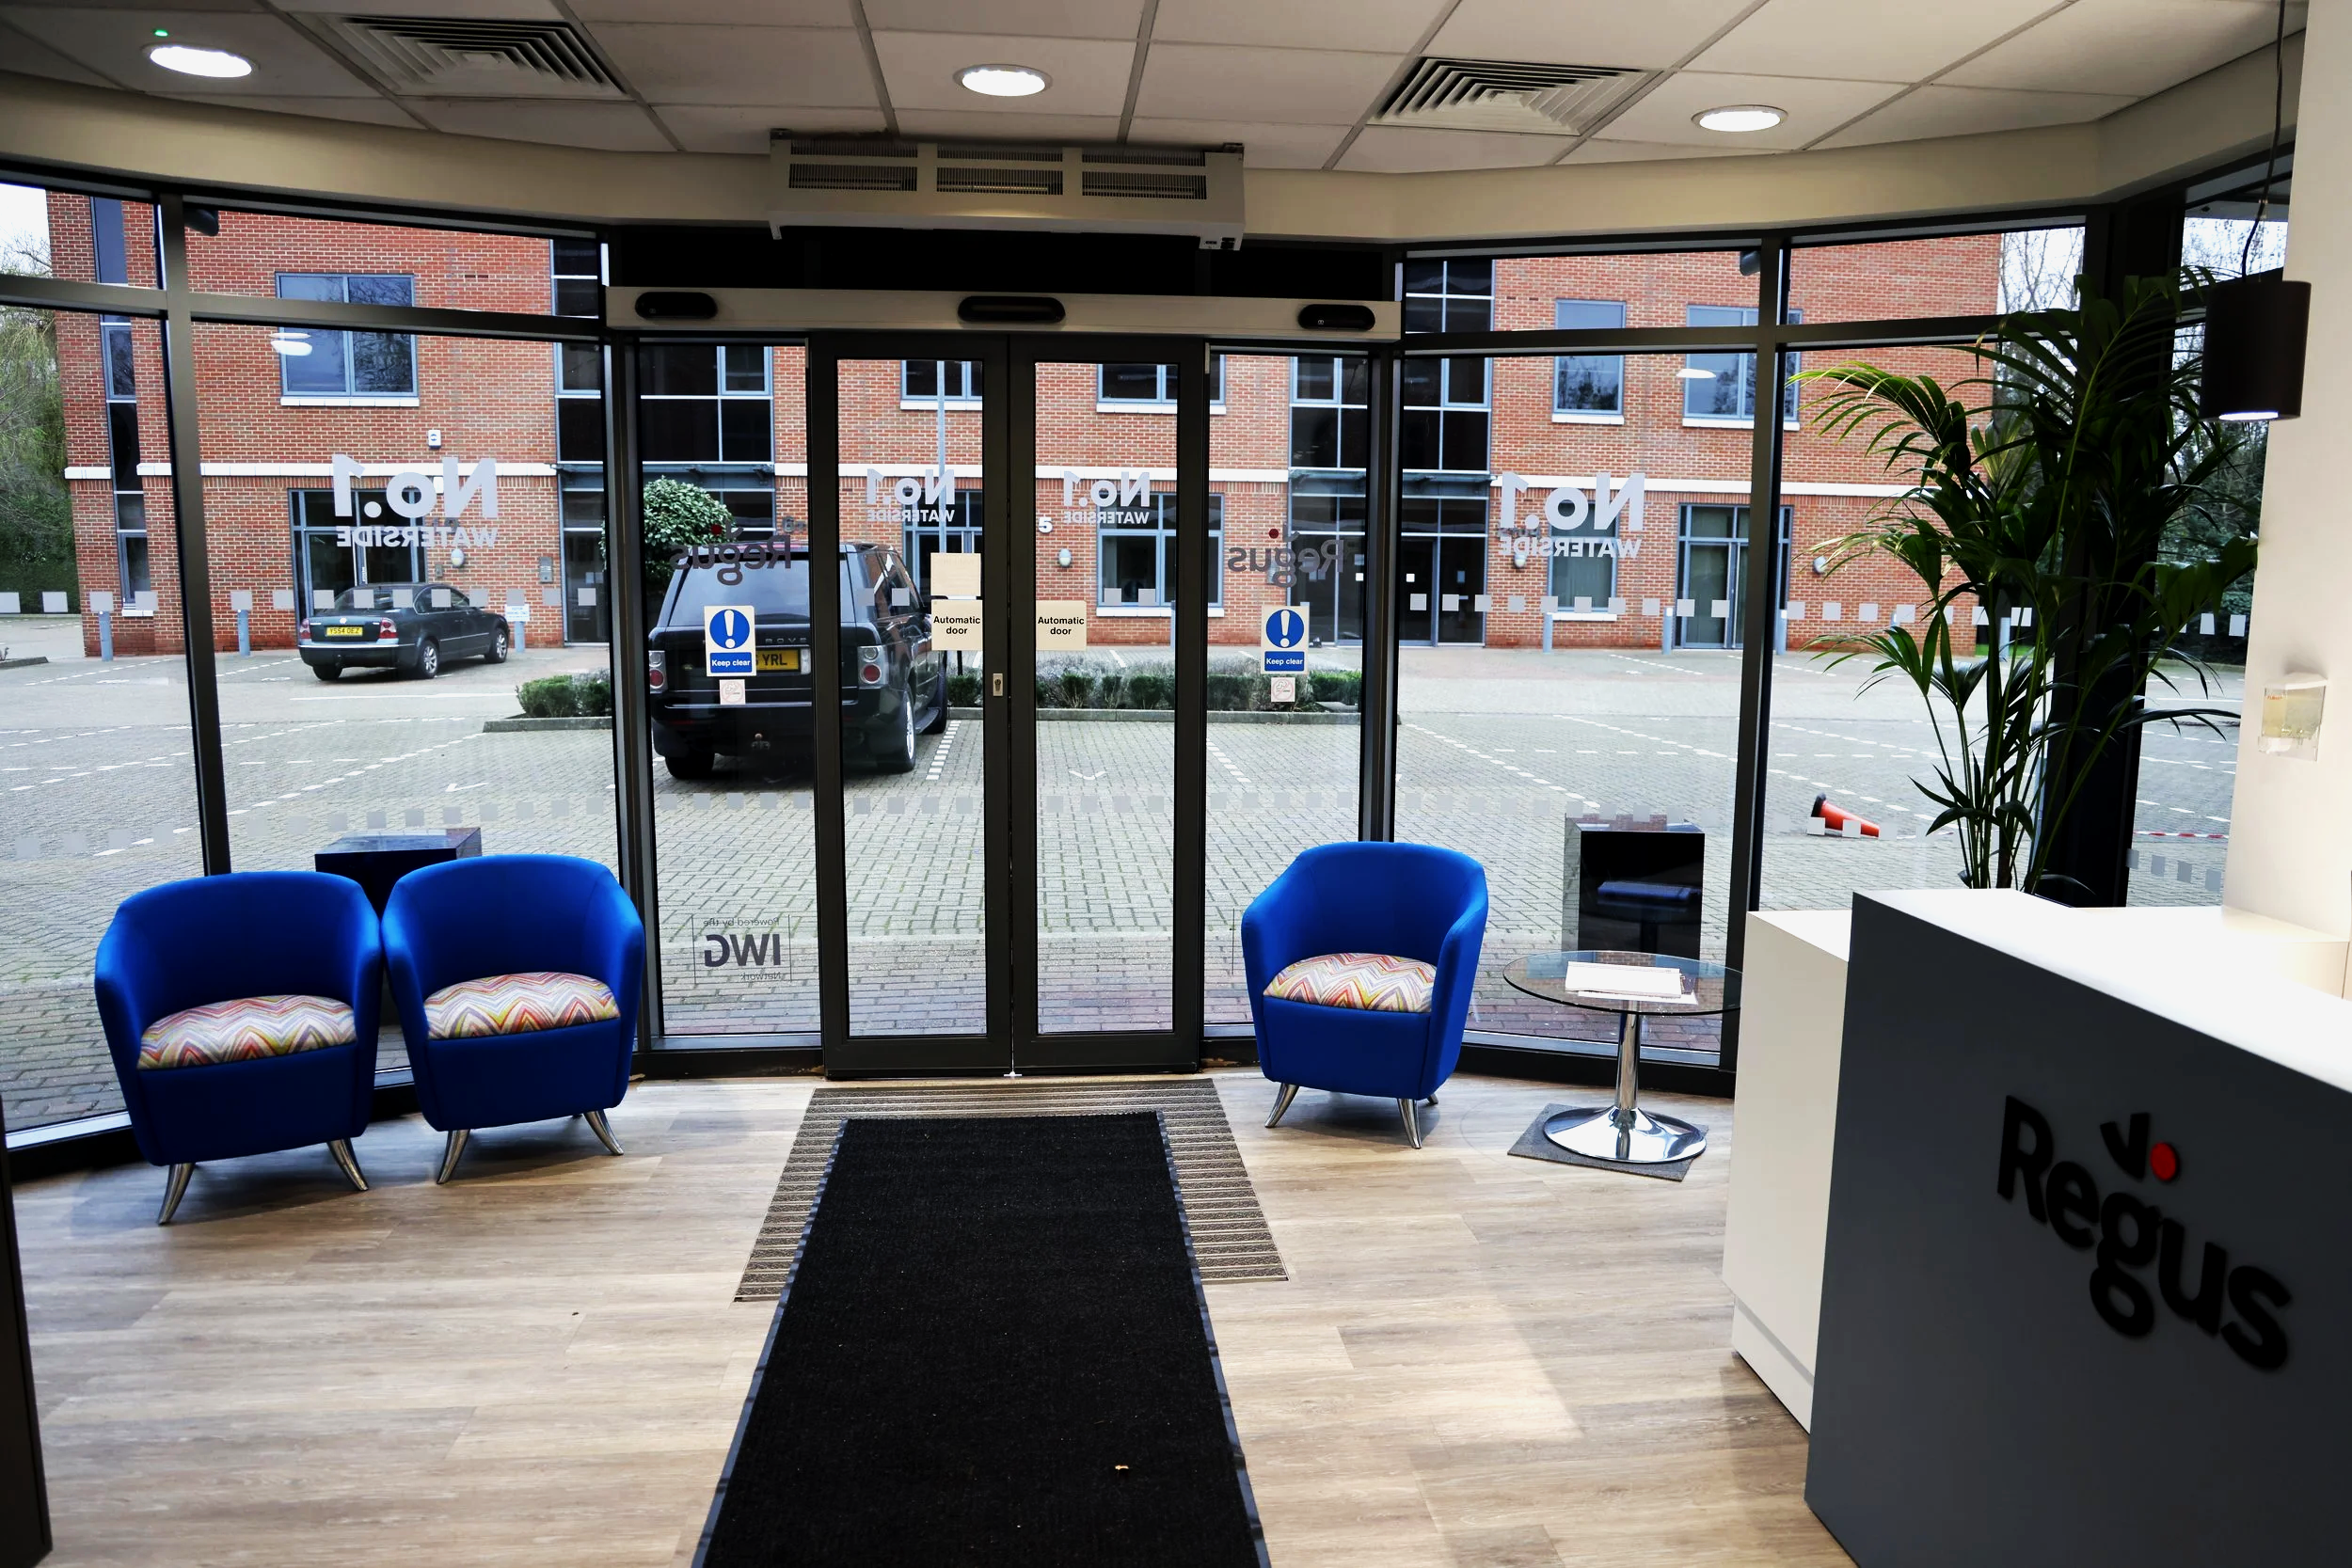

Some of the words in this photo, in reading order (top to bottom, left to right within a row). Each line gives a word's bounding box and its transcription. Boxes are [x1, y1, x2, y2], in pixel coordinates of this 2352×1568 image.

[1038, 516, 1054, 533] 5
[933, 615, 981, 625] Automatic
[1038, 616, 1085, 625] Automatic
[946, 626, 968, 635] door
[1050, 626, 1072, 635] door
[711, 659, 731, 668] Keep
[1265, 657, 1284, 666] Keep
[1996, 1094, 2293, 1373] Regus
